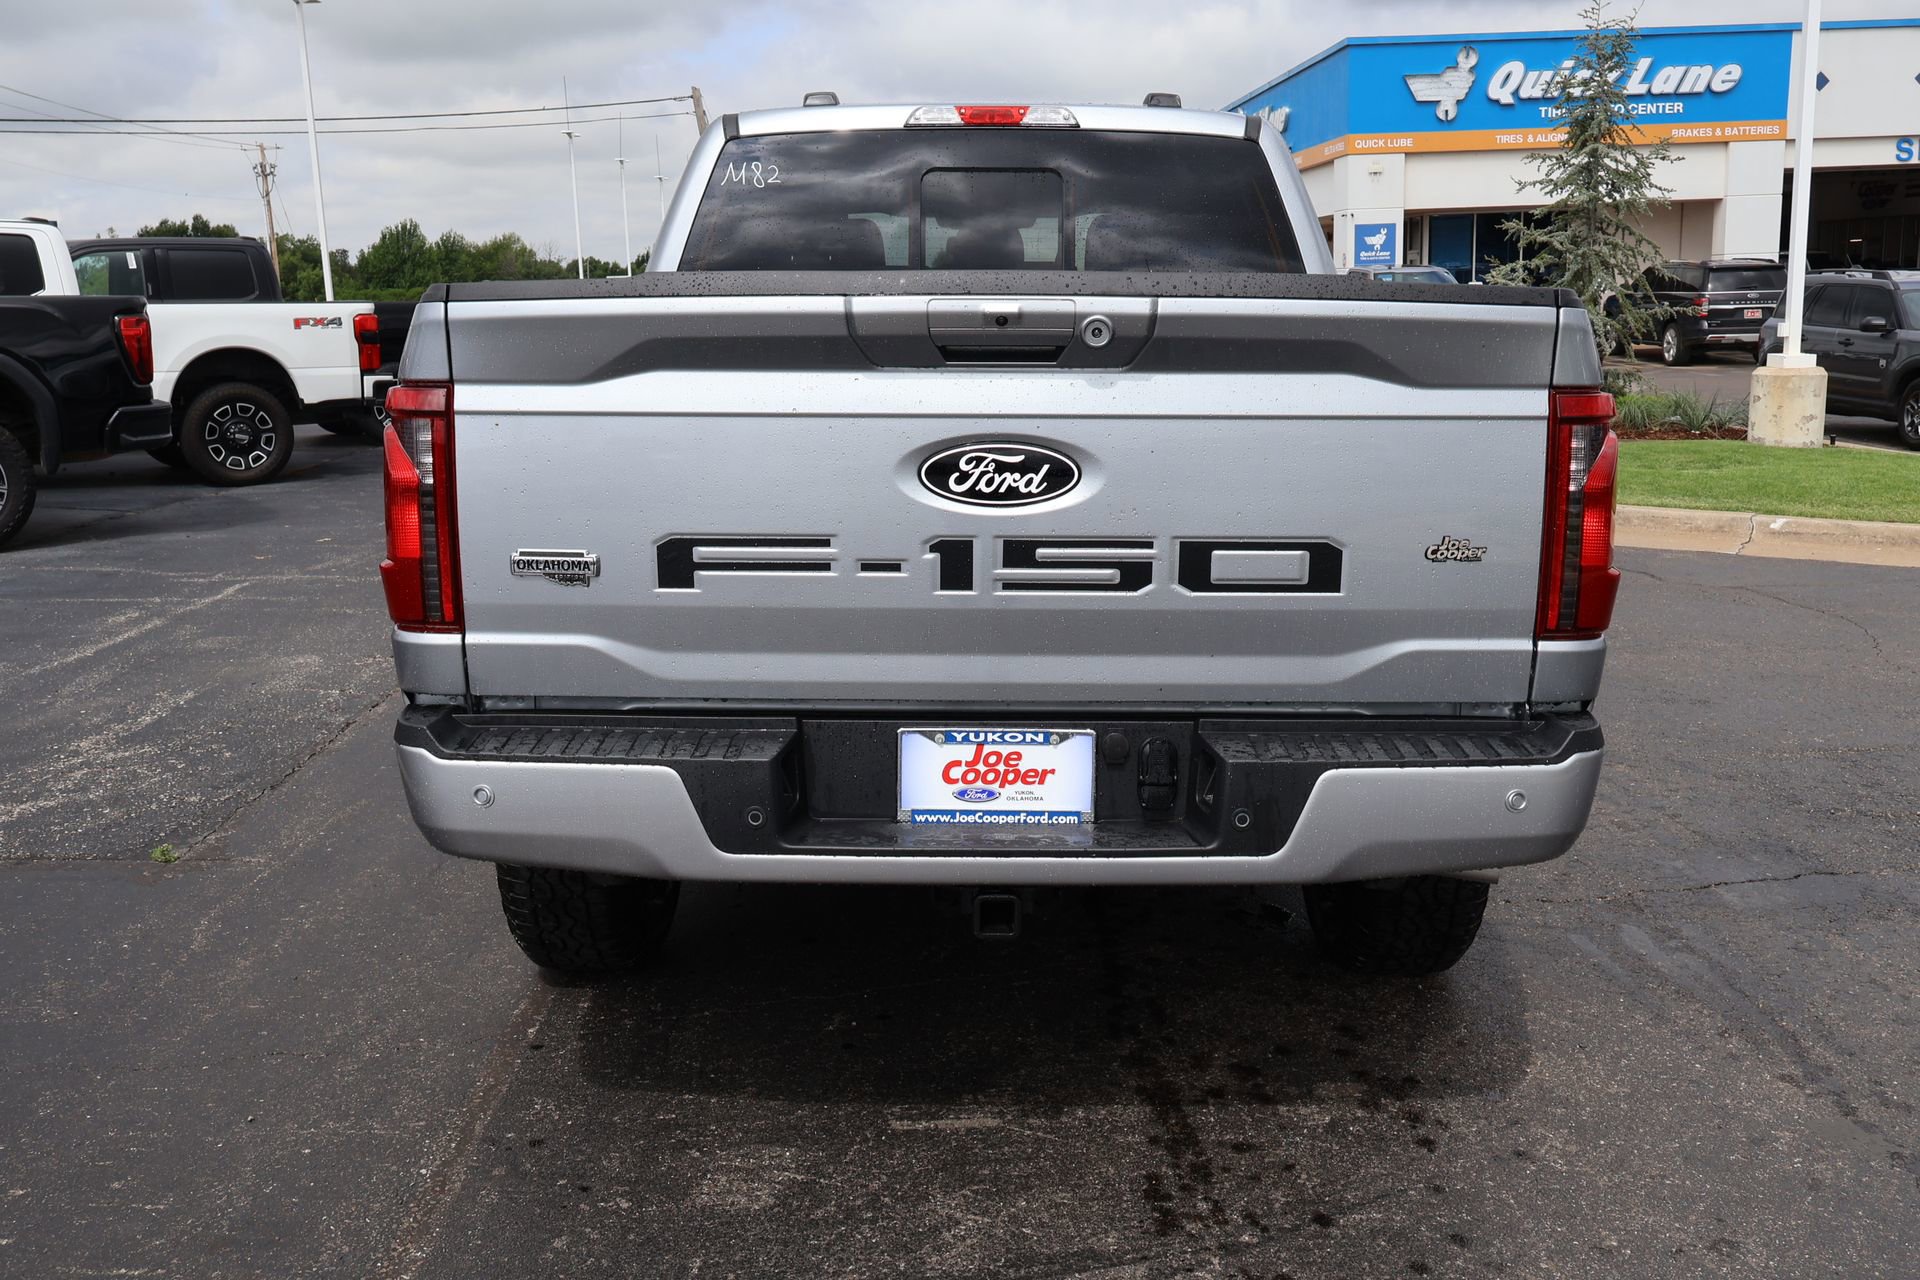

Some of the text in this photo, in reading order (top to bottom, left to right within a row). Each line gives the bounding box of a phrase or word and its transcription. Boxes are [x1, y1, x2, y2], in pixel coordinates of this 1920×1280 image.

[1622, 56, 1743, 97] Lane
[1629, 102, 1684, 115] CENTER
[1495, 132, 1569, 144] TIRES & ALIGN
[1671, 125, 1780, 138] BRAKES & BATTERIES
[1354, 138, 1385, 149] QUICK
[1387, 138, 1414, 147] LUBE
[720, 161, 782, 188] M82
[293, 316, 343, 330] FX4
[948, 446, 1051, 495] Ford
[1439, 535, 1471, 550] Joe
[1424, 544, 1487, 560] Cooper
[516, 559, 591, 571] OKLAHOMA
[655, 536, 1345, 596] F-150
[951, 732, 1045, 743] YUKON
[964, 743, 1023, 768] Joe
[941, 759, 1056, 788] Cooper
[964, 788, 988, 800] Ford
[914, 812, 1079, 825] www.JoeCooperFord.com
